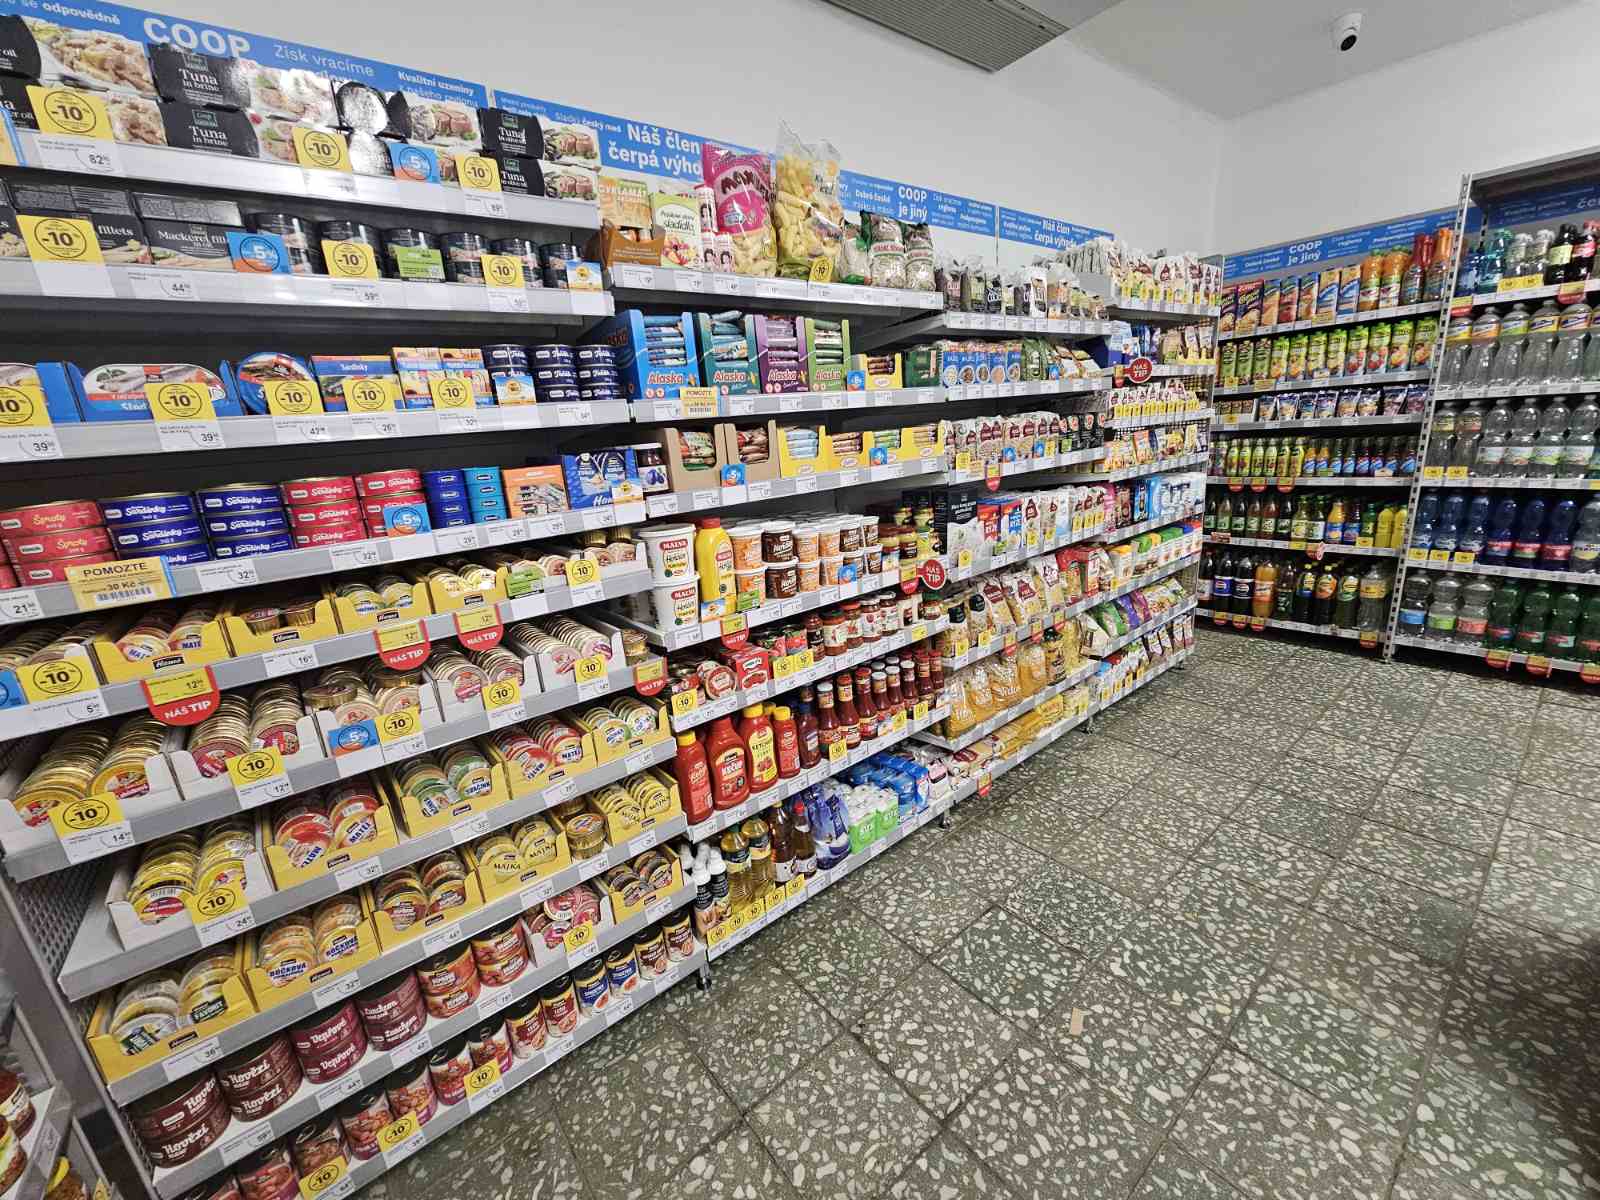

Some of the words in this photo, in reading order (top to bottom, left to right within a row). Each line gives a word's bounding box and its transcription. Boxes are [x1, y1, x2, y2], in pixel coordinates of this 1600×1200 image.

[143, 17, 250, 59] COOP
[179, 68, 218, 86] Tuna
[189, 126, 227, 141] Tuna
[627, 123, 662, 147] Náš
[665, 128, 701, 156] člen
[607, 141, 660, 169] čerpá
[501, 171, 525, 182] Tuna
[898, 185, 928, 202] COOP
[898, 202, 909, 218] je
[910, 203, 928, 222] jiný
[98, 224, 134, 237] fillets
[1289, 240, 1323, 256] COOP
[1300, 251, 1322, 266] jiný
[649, 372, 684, 386] Alaska
[714, 370, 746, 384] Alaska
[768, 370, 798, 382] Alaska
[816, 370, 841, 381] Alaska
[83, 562, 148, 577] POMOZTE
[928, 573, 942, 583] TIP
